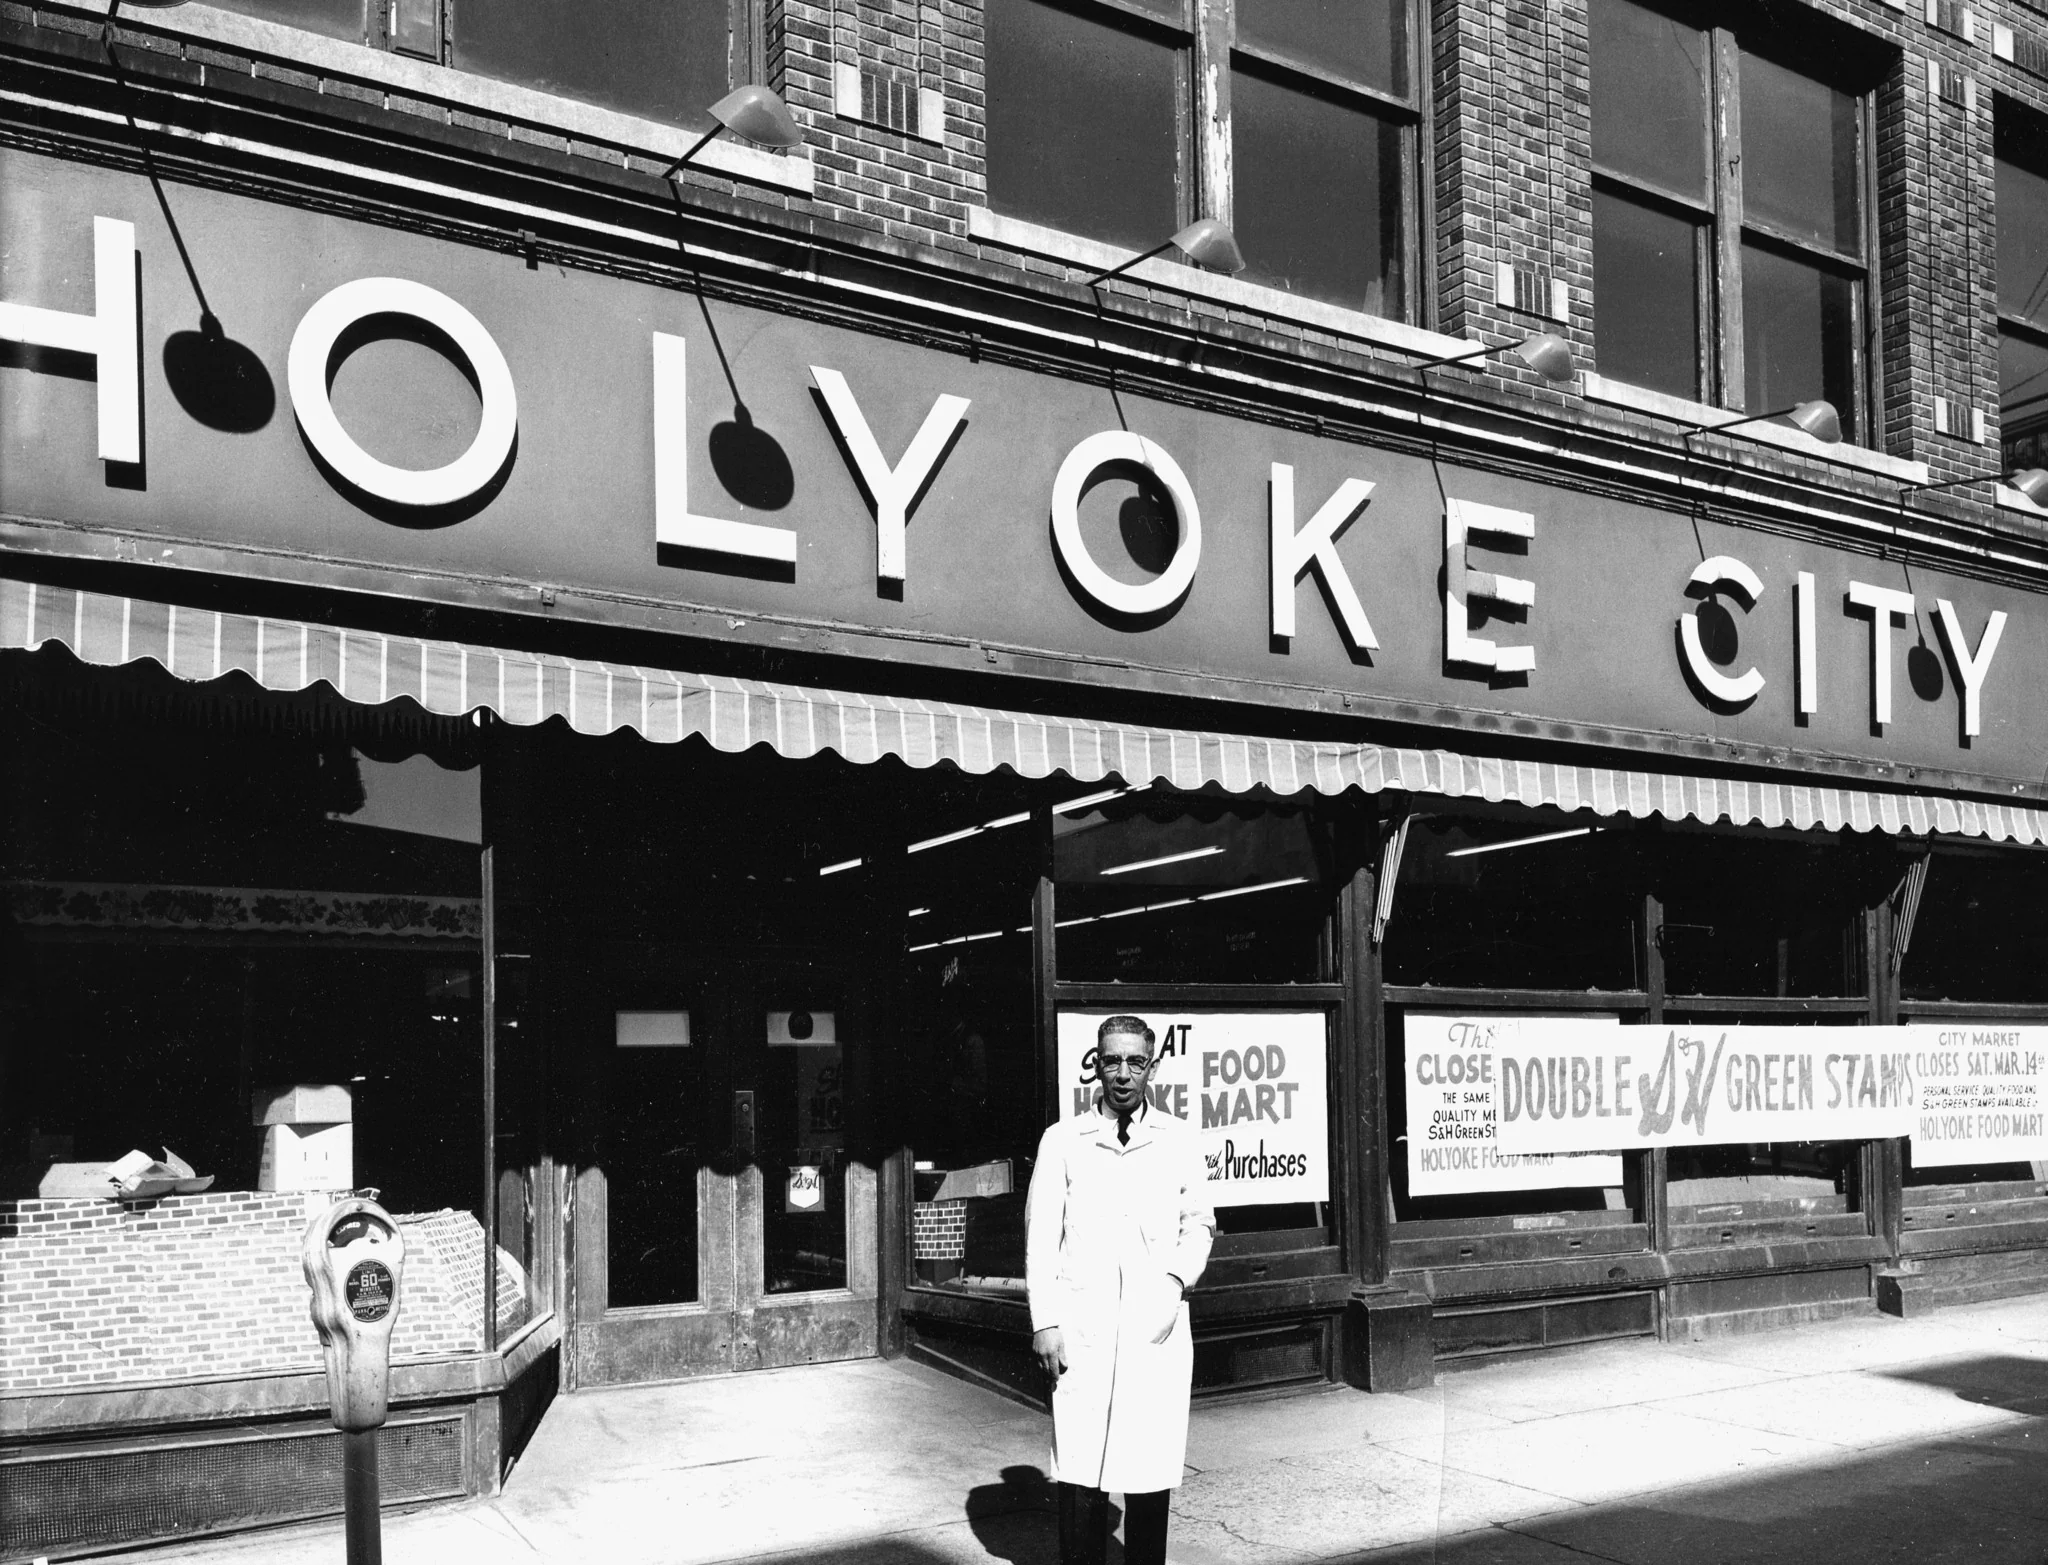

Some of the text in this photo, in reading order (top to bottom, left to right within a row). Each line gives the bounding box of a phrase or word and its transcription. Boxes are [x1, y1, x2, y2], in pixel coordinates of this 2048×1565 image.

[0, 215, 2009, 737] HOLYOKE CITY
[1159, 1023, 1192, 1059] AT
[1448, 1022, 1495, 1049] Thi
[1938, 1032, 2021, 1048] CITY MARKET
[1202, 1045, 1287, 1087] FOOD
[1416, 1053, 1494, 1085] CLOSE
[1916, 1051, 1960, 1077] CLOSES
[1442, 1092, 1490, 1104] THE SAME
[1501, 1055, 1633, 1122] DOUBLE
[1726, 1053, 1814, 1113] GREEN
[1825, 1052, 1914, 1110] STAMPS
[1923, 1086, 1951, 1097] PERSONAL
[2007, 1084, 2023, 1096] FOOD
[2024, 1084, 2037, 1095] AND
[1201, 1082, 1300, 1130] MART
[1433, 1109, 1477, 1124] QUALITY
[1942, 1098, 1968, 1109] GREEN
[1970, 1097, 1996, 1108] STAMPS
[1997, 1097, 2031, 1108] AVAILABLE
[1428, 1124, 1453, 1140] S&H
[1455, 1123, 1484, 1140] GREEN
[1920, 1113, 2044, 1141] HOLYOKE FOOD MART
[1225, 1138, 1308, 1181] Purchases
[1421, 1146, 1479, 1173] HOLYOKE
[360, 1273, 378, 1288] 60
